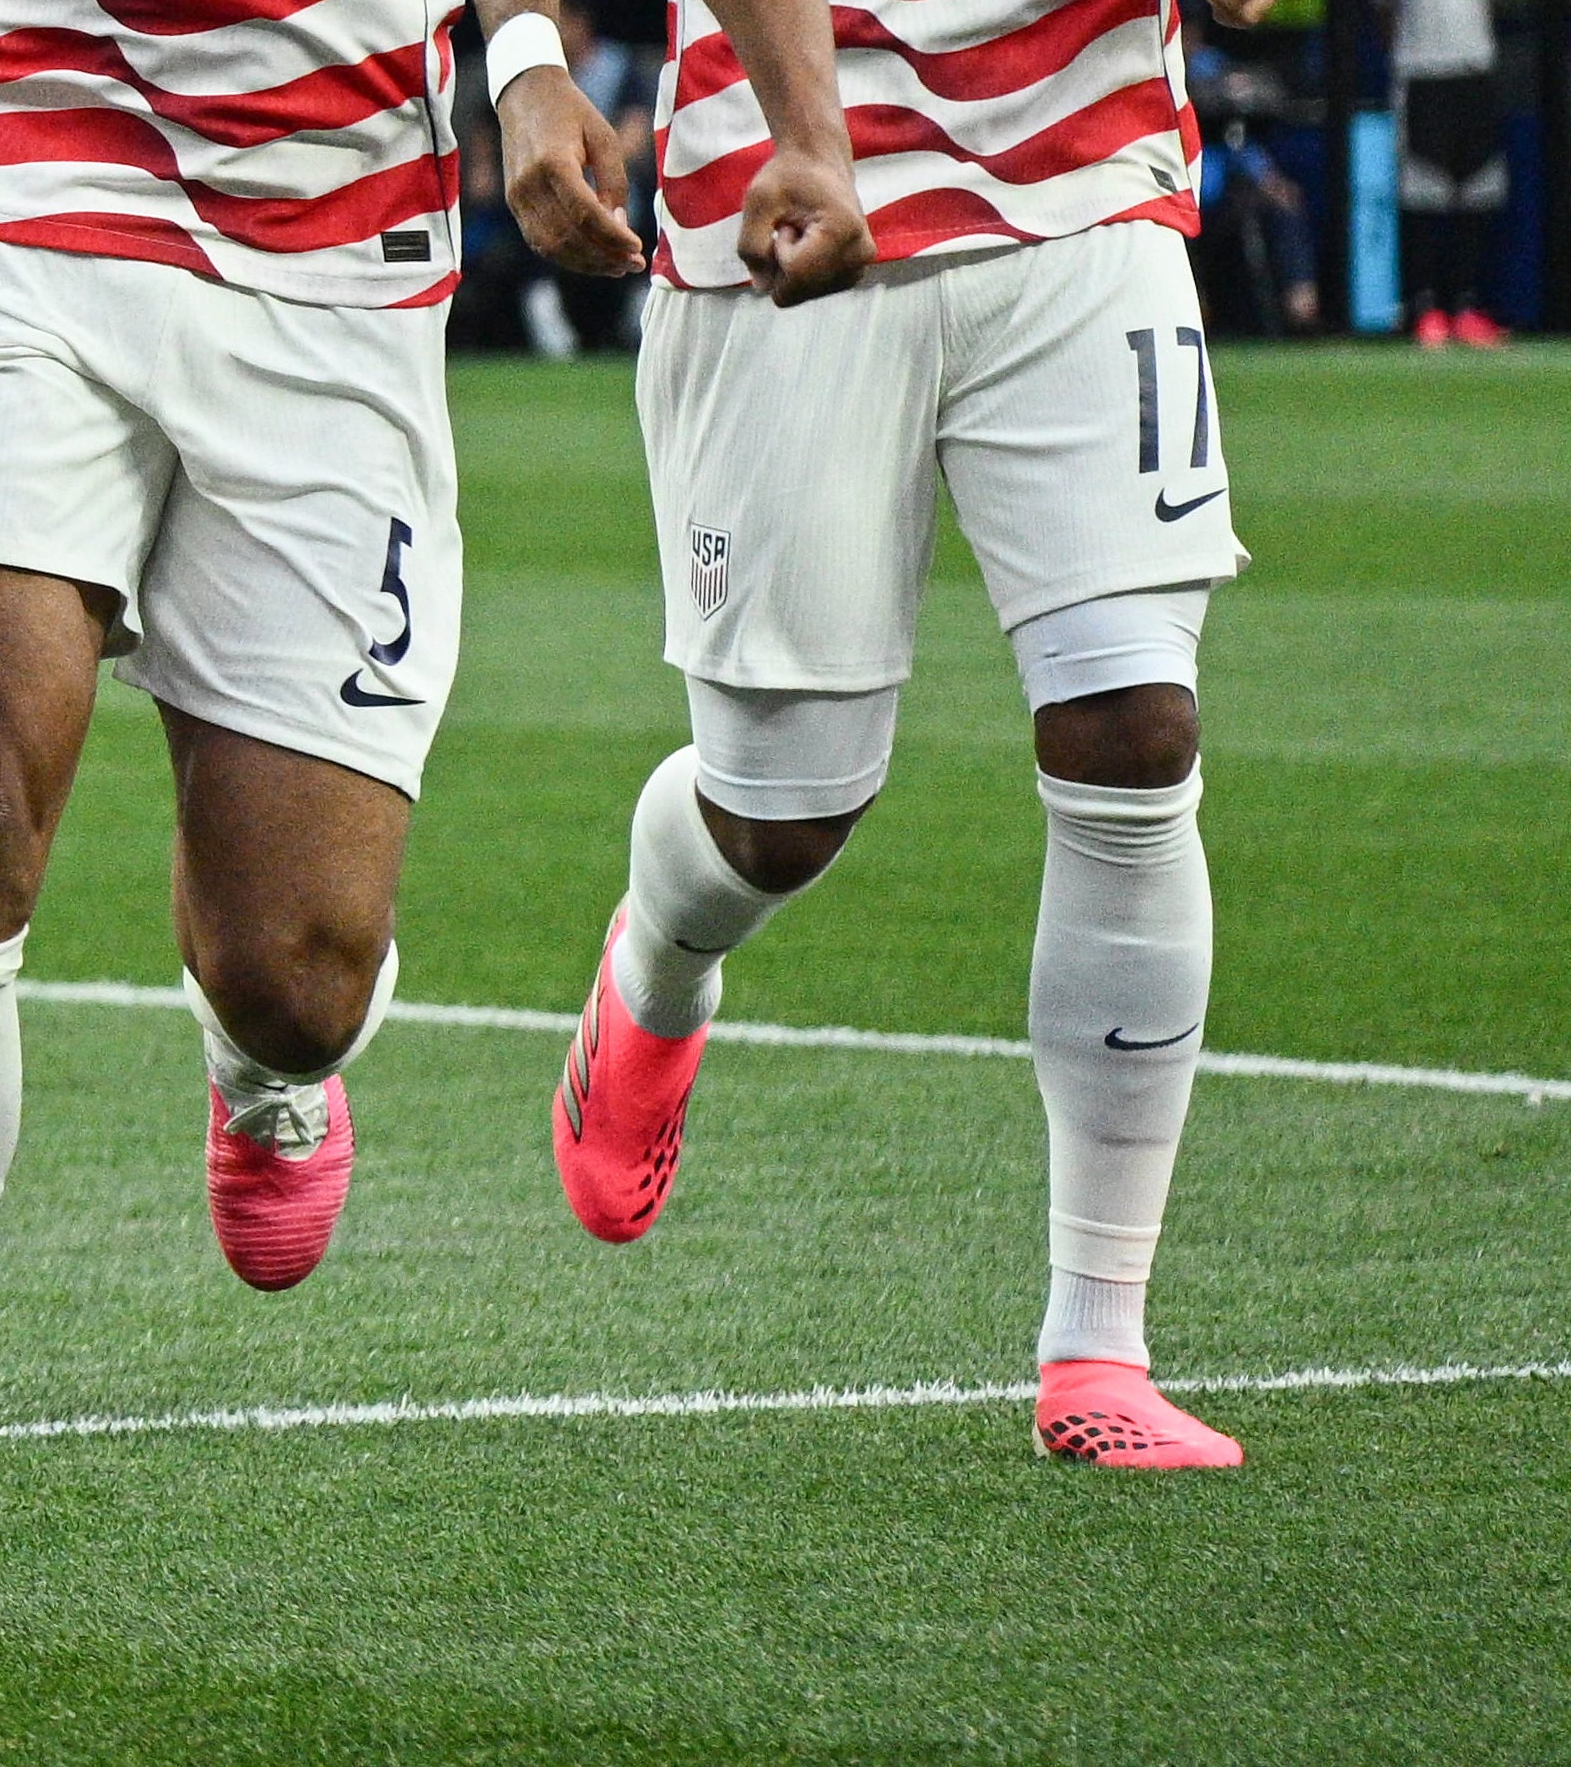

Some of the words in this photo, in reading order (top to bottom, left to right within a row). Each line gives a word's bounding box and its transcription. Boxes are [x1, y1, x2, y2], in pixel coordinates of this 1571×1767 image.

[1126, 326, 1209, 474] 17
[369, 516, 413, 667] 5
[692, 529, 726, 566] USA
